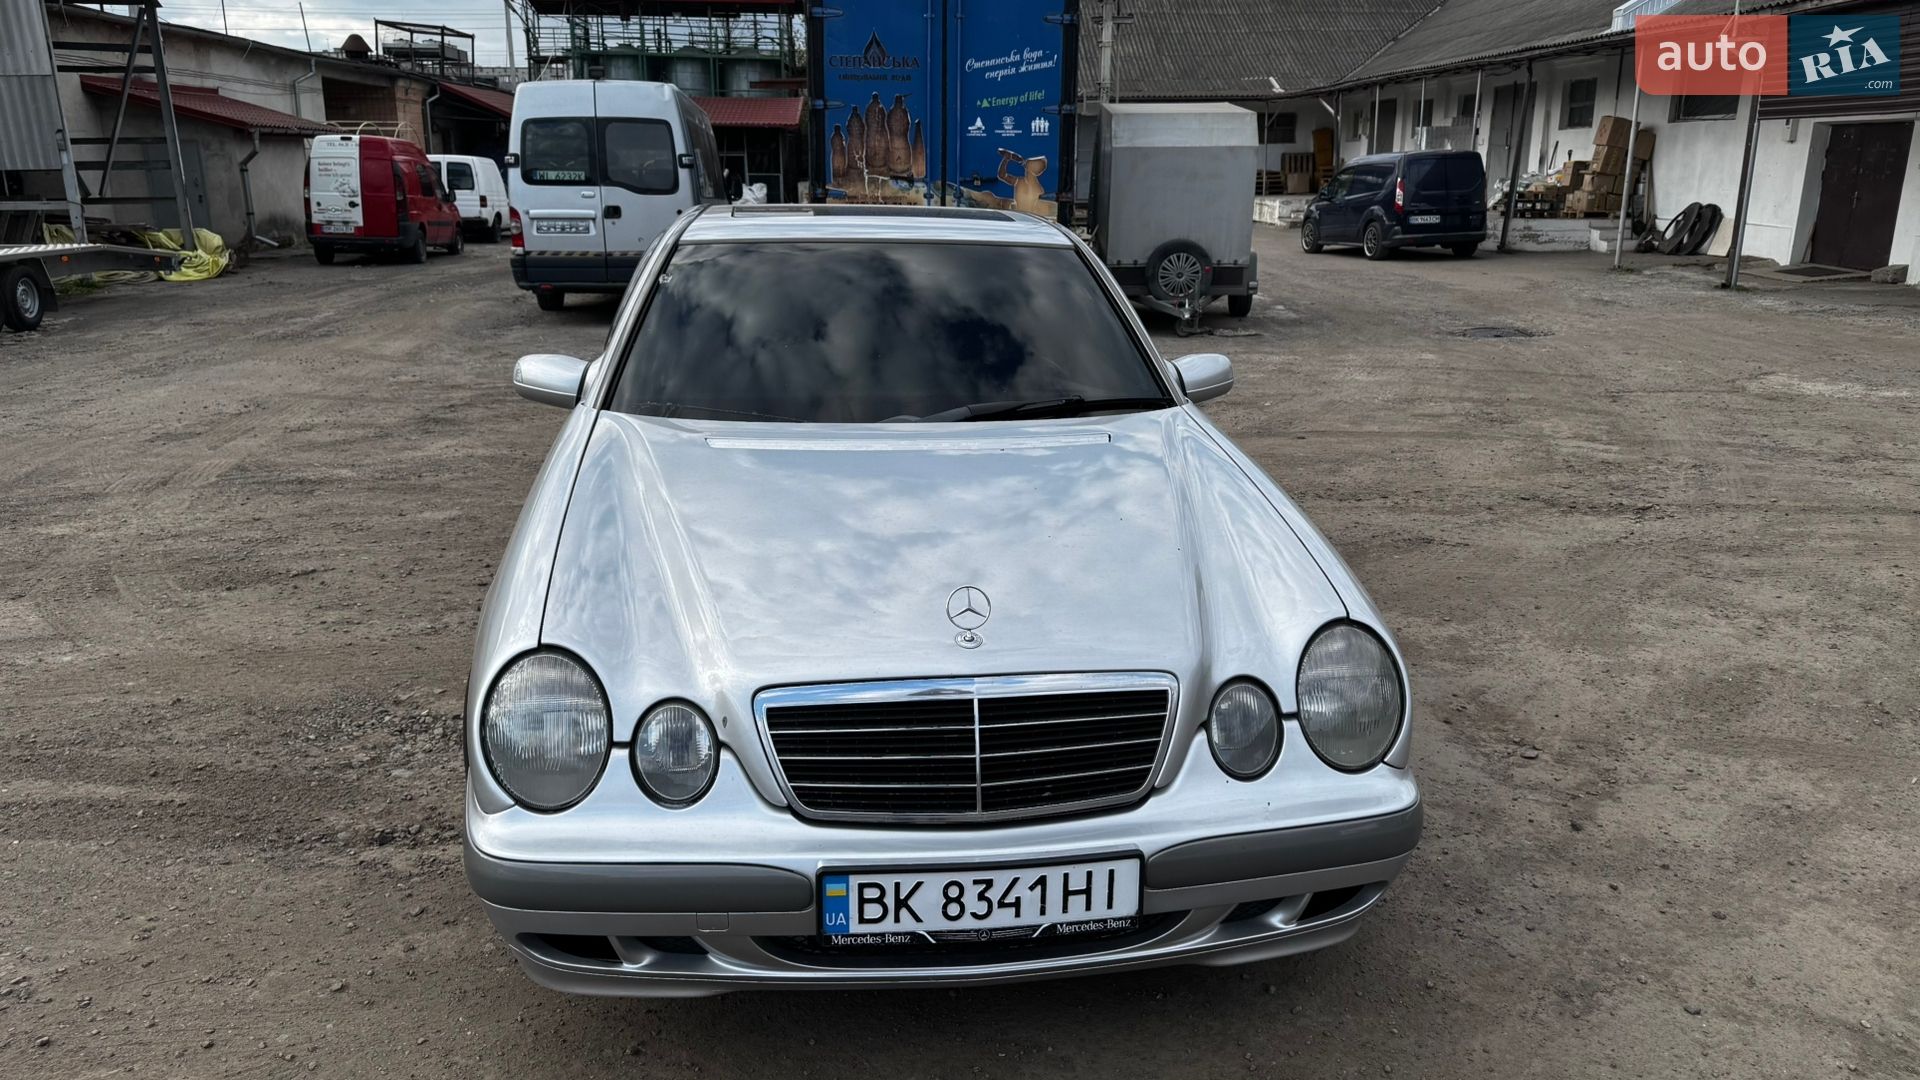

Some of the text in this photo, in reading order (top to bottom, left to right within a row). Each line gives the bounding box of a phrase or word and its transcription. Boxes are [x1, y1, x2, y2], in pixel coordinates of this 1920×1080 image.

[829, 55, 921, 69] СТЕПАНСЬКА
[965, 49, 1020, 73] Степанська
[1022, 47, 1043, 62] вода
[985, 54, 1058, 81] енергія життя!
[992, 89, 1045, 107] Energy of life!
[857, 868, 1115, 925] BK 8341 HI
[826, 913, 846, 926] UA
[1056, 918, 1132, 935] Mercedes-Benz
[831, 933, 911, 945] Mercedes-Benz
